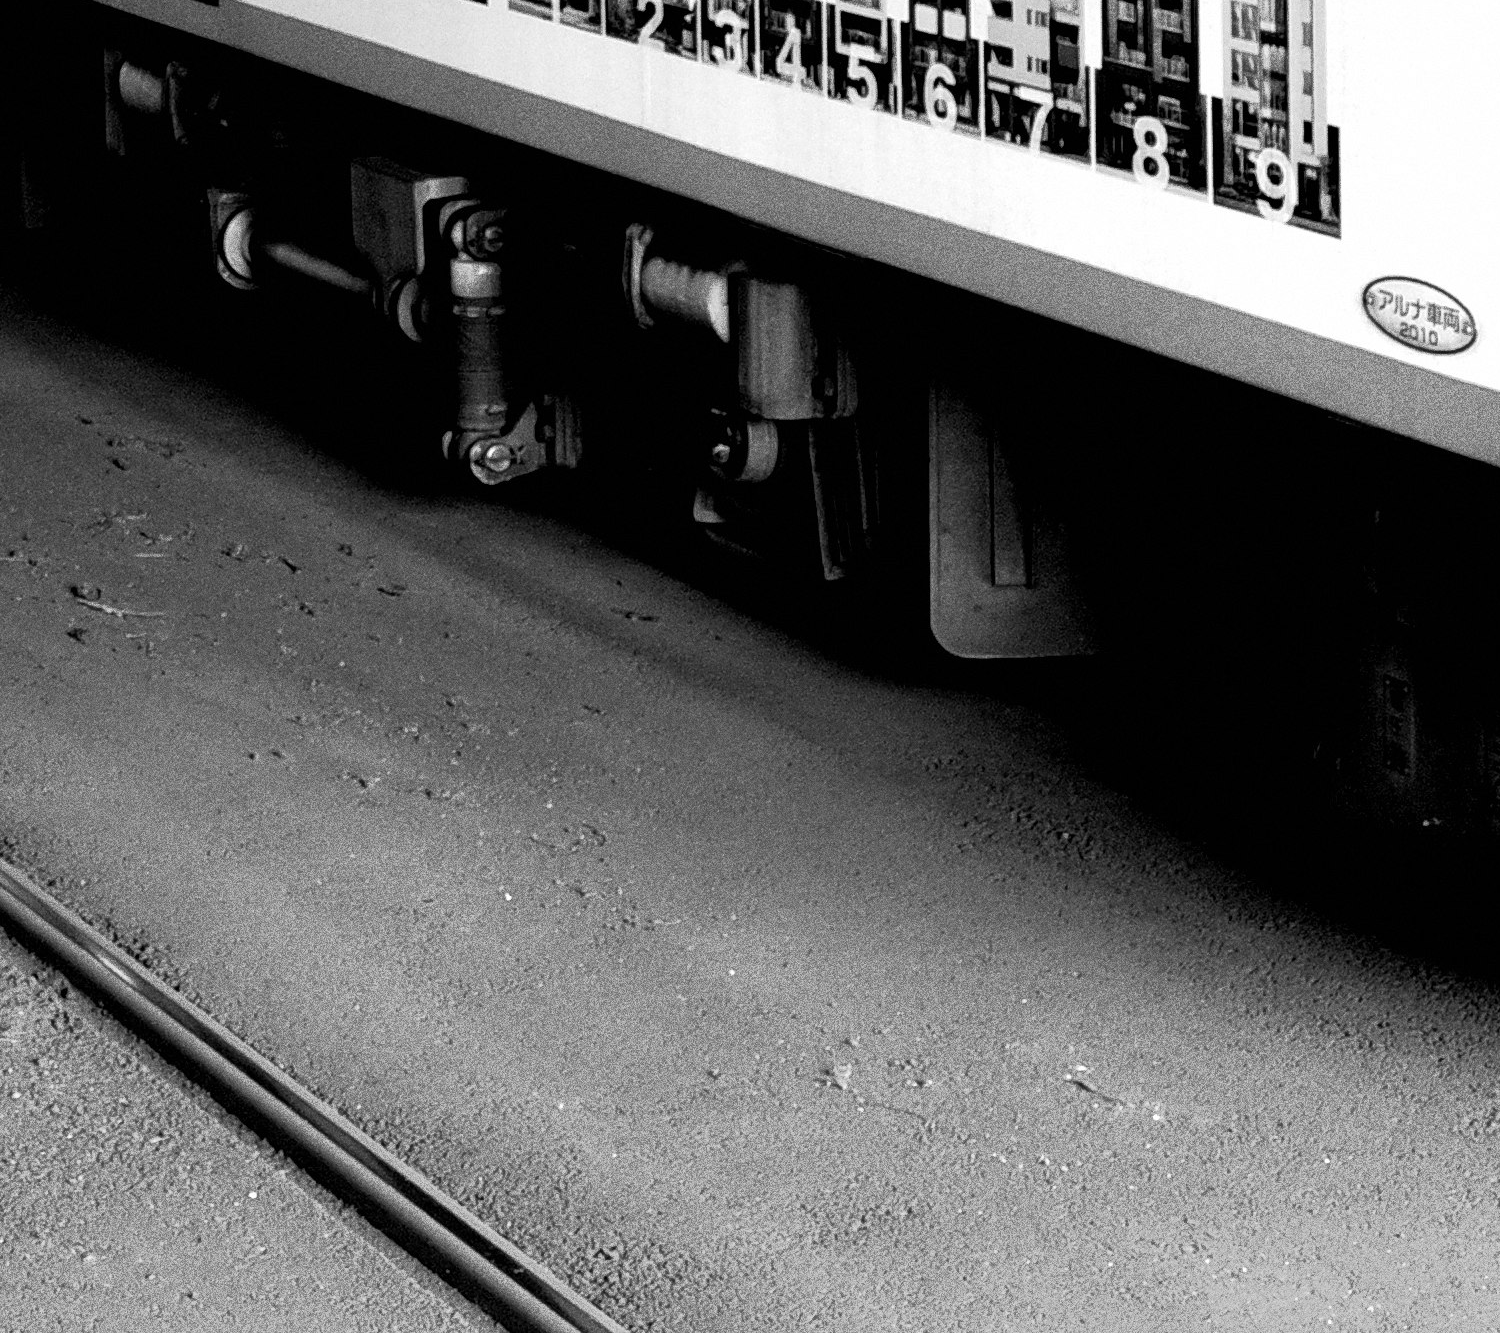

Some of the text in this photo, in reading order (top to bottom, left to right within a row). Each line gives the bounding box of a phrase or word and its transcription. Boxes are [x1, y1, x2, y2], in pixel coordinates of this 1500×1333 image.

[713, 8, 749, 72] 3
[775, 23, 807, 90] 4
[846, 44, 879, 112] 5
[923, 63, 958, 132] 6
[1013, 85, 1054, 157] 7
[1132, 115, 1170, 191] 8
[1255, 147, 1299, 225] 9
[1378, 289, 1461, 334] アルナ車両
[1399, 321, 1439, 347] 2010
